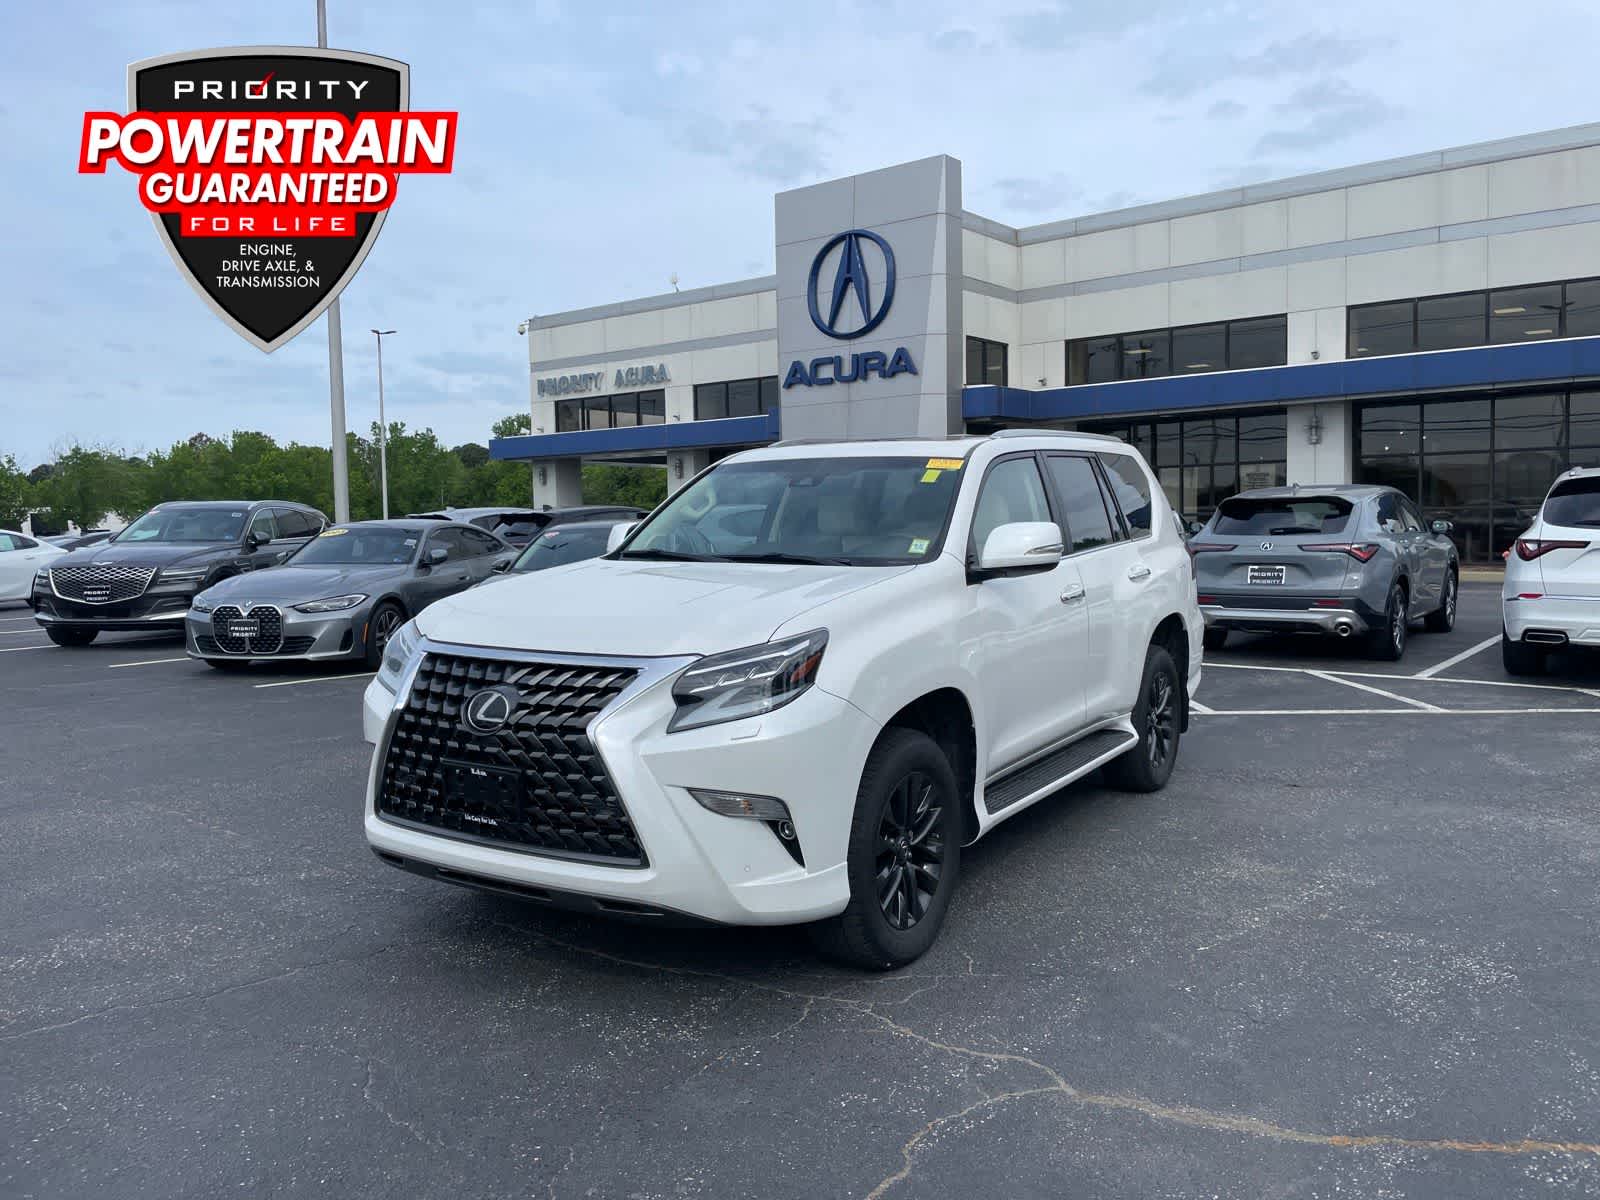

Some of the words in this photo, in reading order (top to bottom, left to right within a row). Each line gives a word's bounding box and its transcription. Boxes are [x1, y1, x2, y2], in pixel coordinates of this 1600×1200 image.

[536, 371, 605, 398] PRIORITY
[614, 363, 671, 388] ACURA
[782, 346, 919, 390] ACURA
